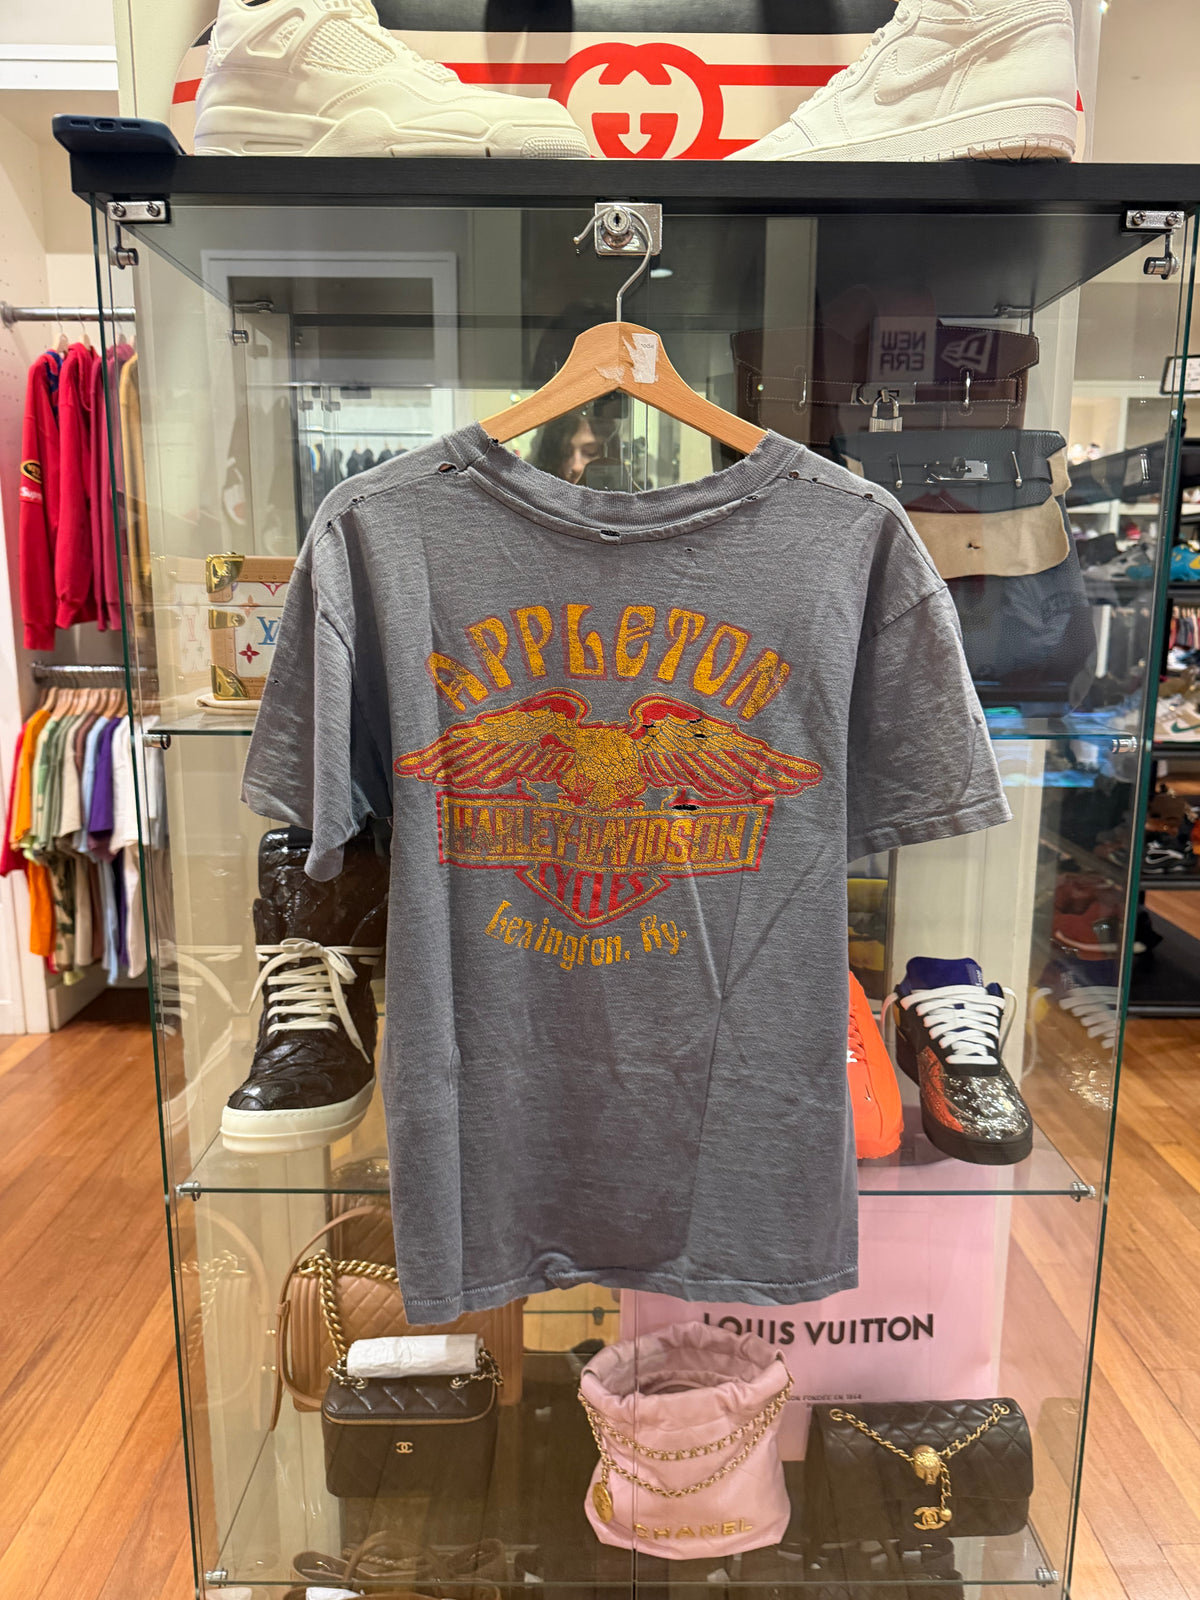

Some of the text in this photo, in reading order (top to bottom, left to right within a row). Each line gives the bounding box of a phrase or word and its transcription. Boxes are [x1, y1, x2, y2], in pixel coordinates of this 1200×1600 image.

[425, 603, 791, 721] APPLETON
[452, 806, 747, 866] HARLEY-DAVIDSON
[539, 862, 649, 920] CYCLES
[804, 1314, 934, 1345] VUITTON
[633, 1518, 753, 1539] CHANEL
